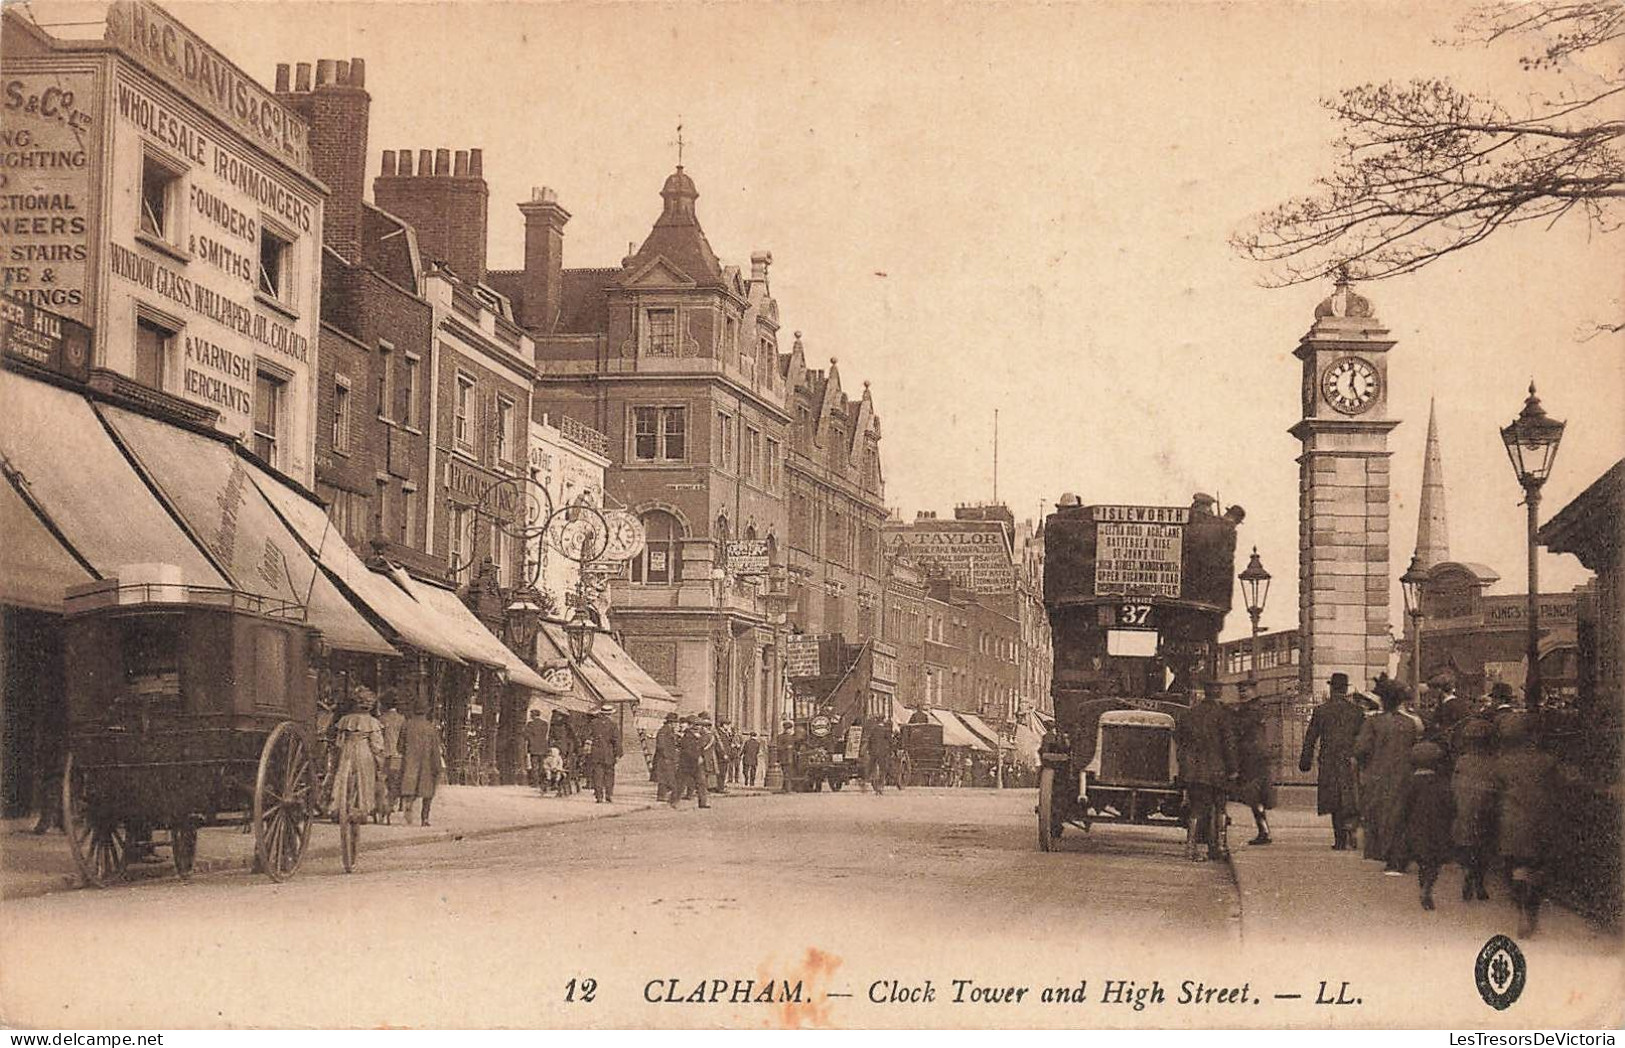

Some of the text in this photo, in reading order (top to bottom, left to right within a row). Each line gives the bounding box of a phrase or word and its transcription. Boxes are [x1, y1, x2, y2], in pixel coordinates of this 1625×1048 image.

[118, 83, 206, 167] WHOLESALE
[190, 183, 255, 243] FOUNDERS
[11, 244, 87, 261] STAIRS
[40, 267, 56, 283] &
[110, 242, 155, 291] WINDOW
[195, 336, 251, 383] VARNISH
[1102, 507, 1183, 522] ISLEWORTH
[915, 533, 999, 545] TAYLOR
[1122, 605, 1151, 624] 37
